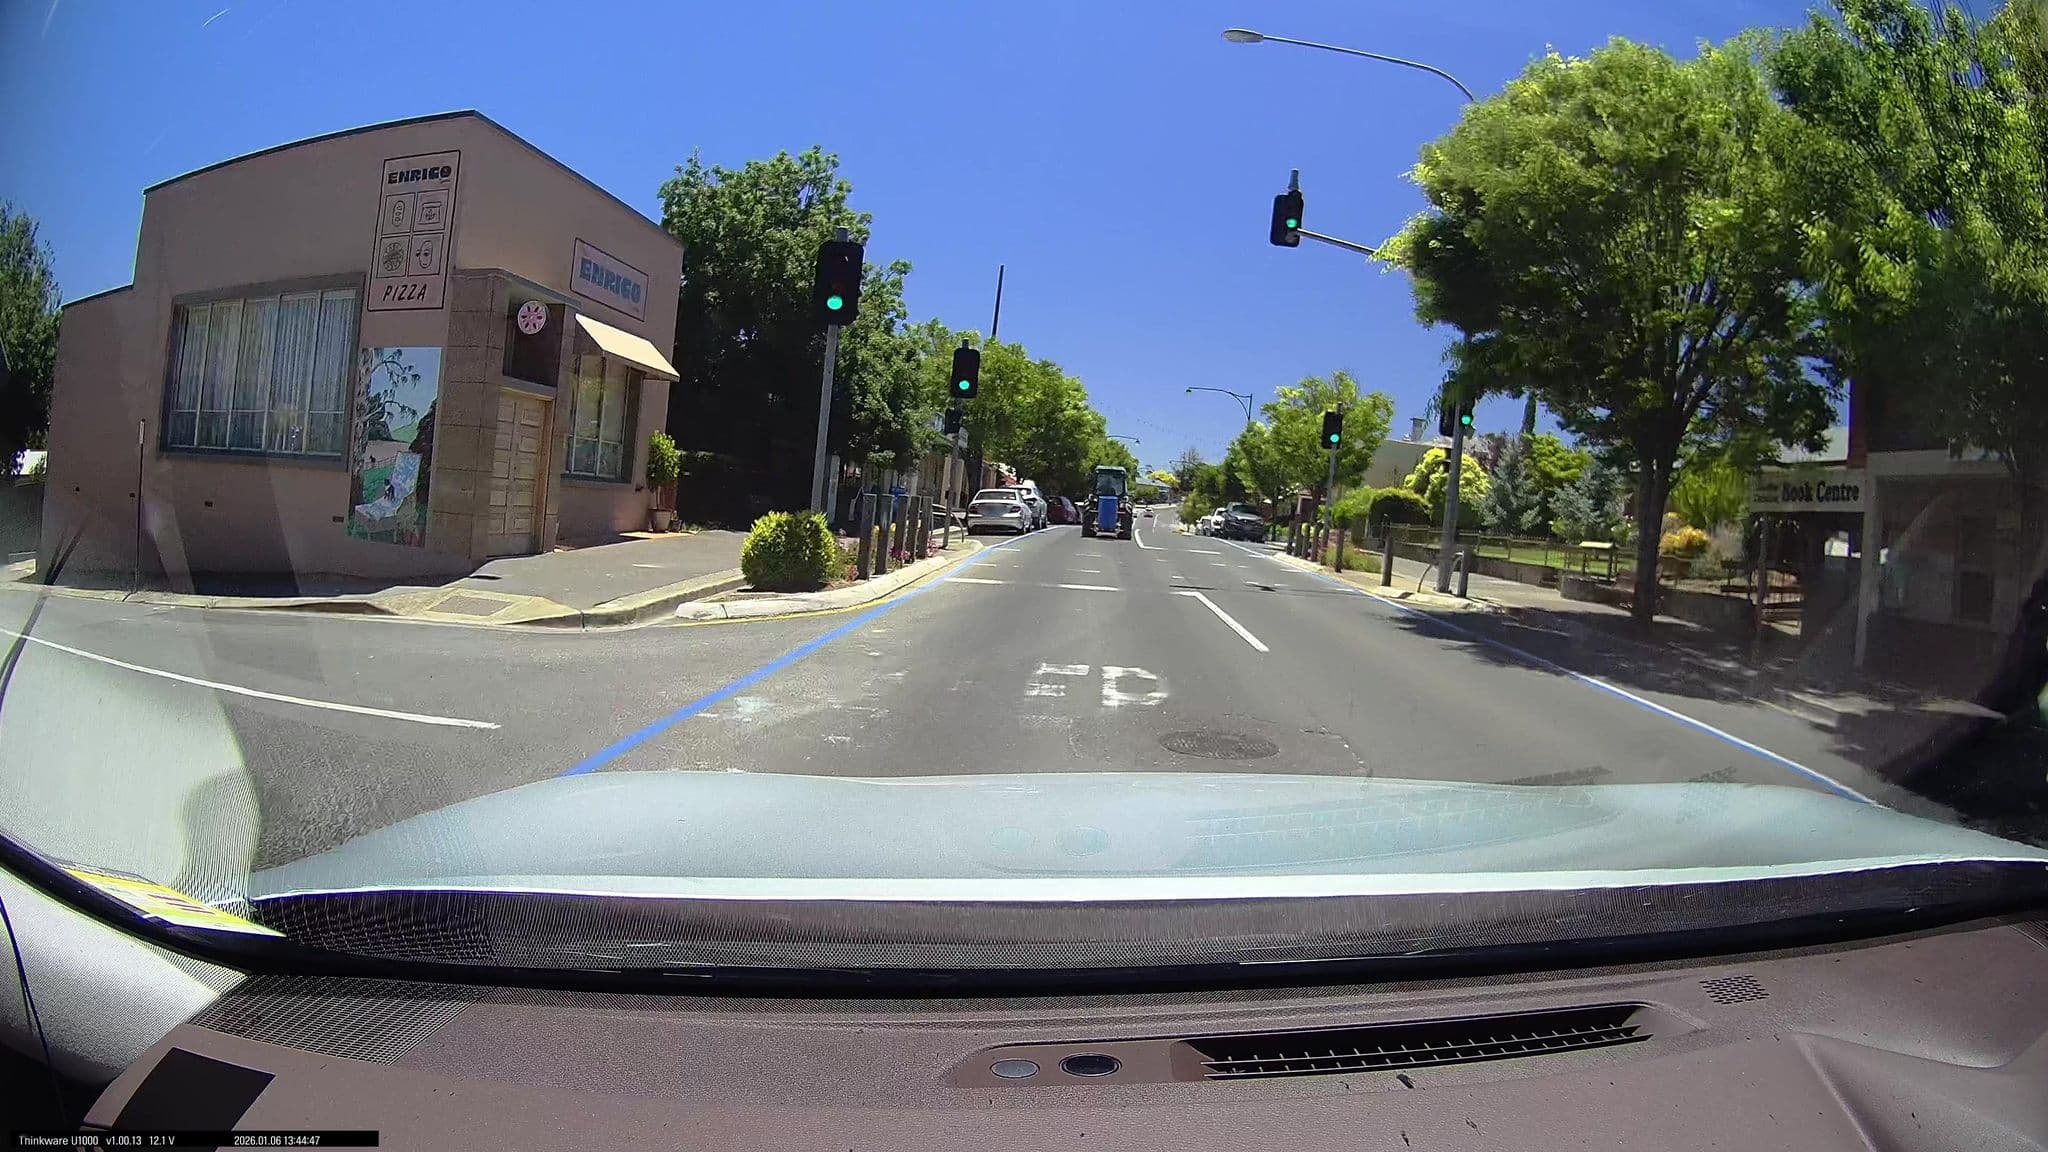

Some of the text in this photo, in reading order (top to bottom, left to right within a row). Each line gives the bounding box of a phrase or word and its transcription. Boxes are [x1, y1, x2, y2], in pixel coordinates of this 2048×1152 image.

[387, 165, 452, 184] ENRICO
[579, 256, 642, 304] ENRICO
[382, 284, 427, 302] PIZZA
[1782, 481, 1813, 503] Book
[1816, 480, 1860, 503] Centre
